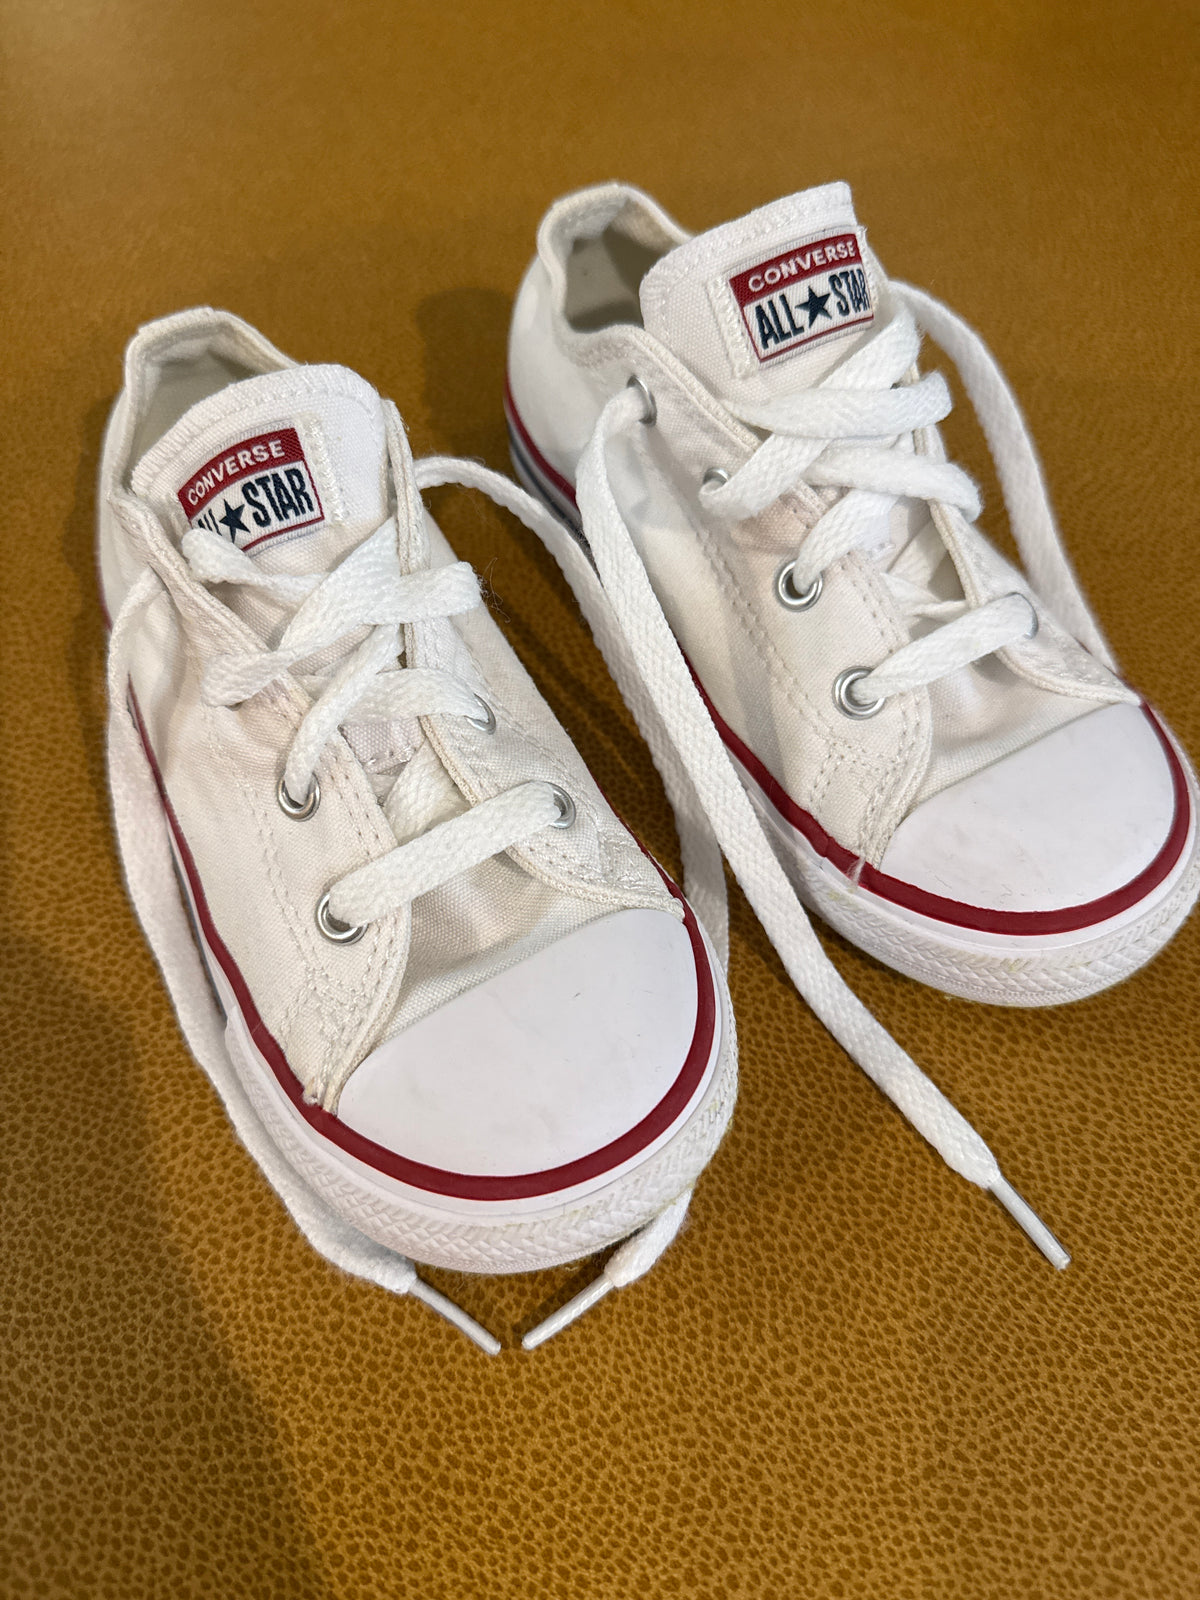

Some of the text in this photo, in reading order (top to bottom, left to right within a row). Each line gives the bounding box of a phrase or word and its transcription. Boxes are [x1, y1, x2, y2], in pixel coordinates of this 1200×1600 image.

[748, 241, 856, 292] CONVERSE
[755, 269, 870, 350] ALL STAR
[188, 440, 285, 505] CONVERSE
[241, 468, 314, 527] STAR
